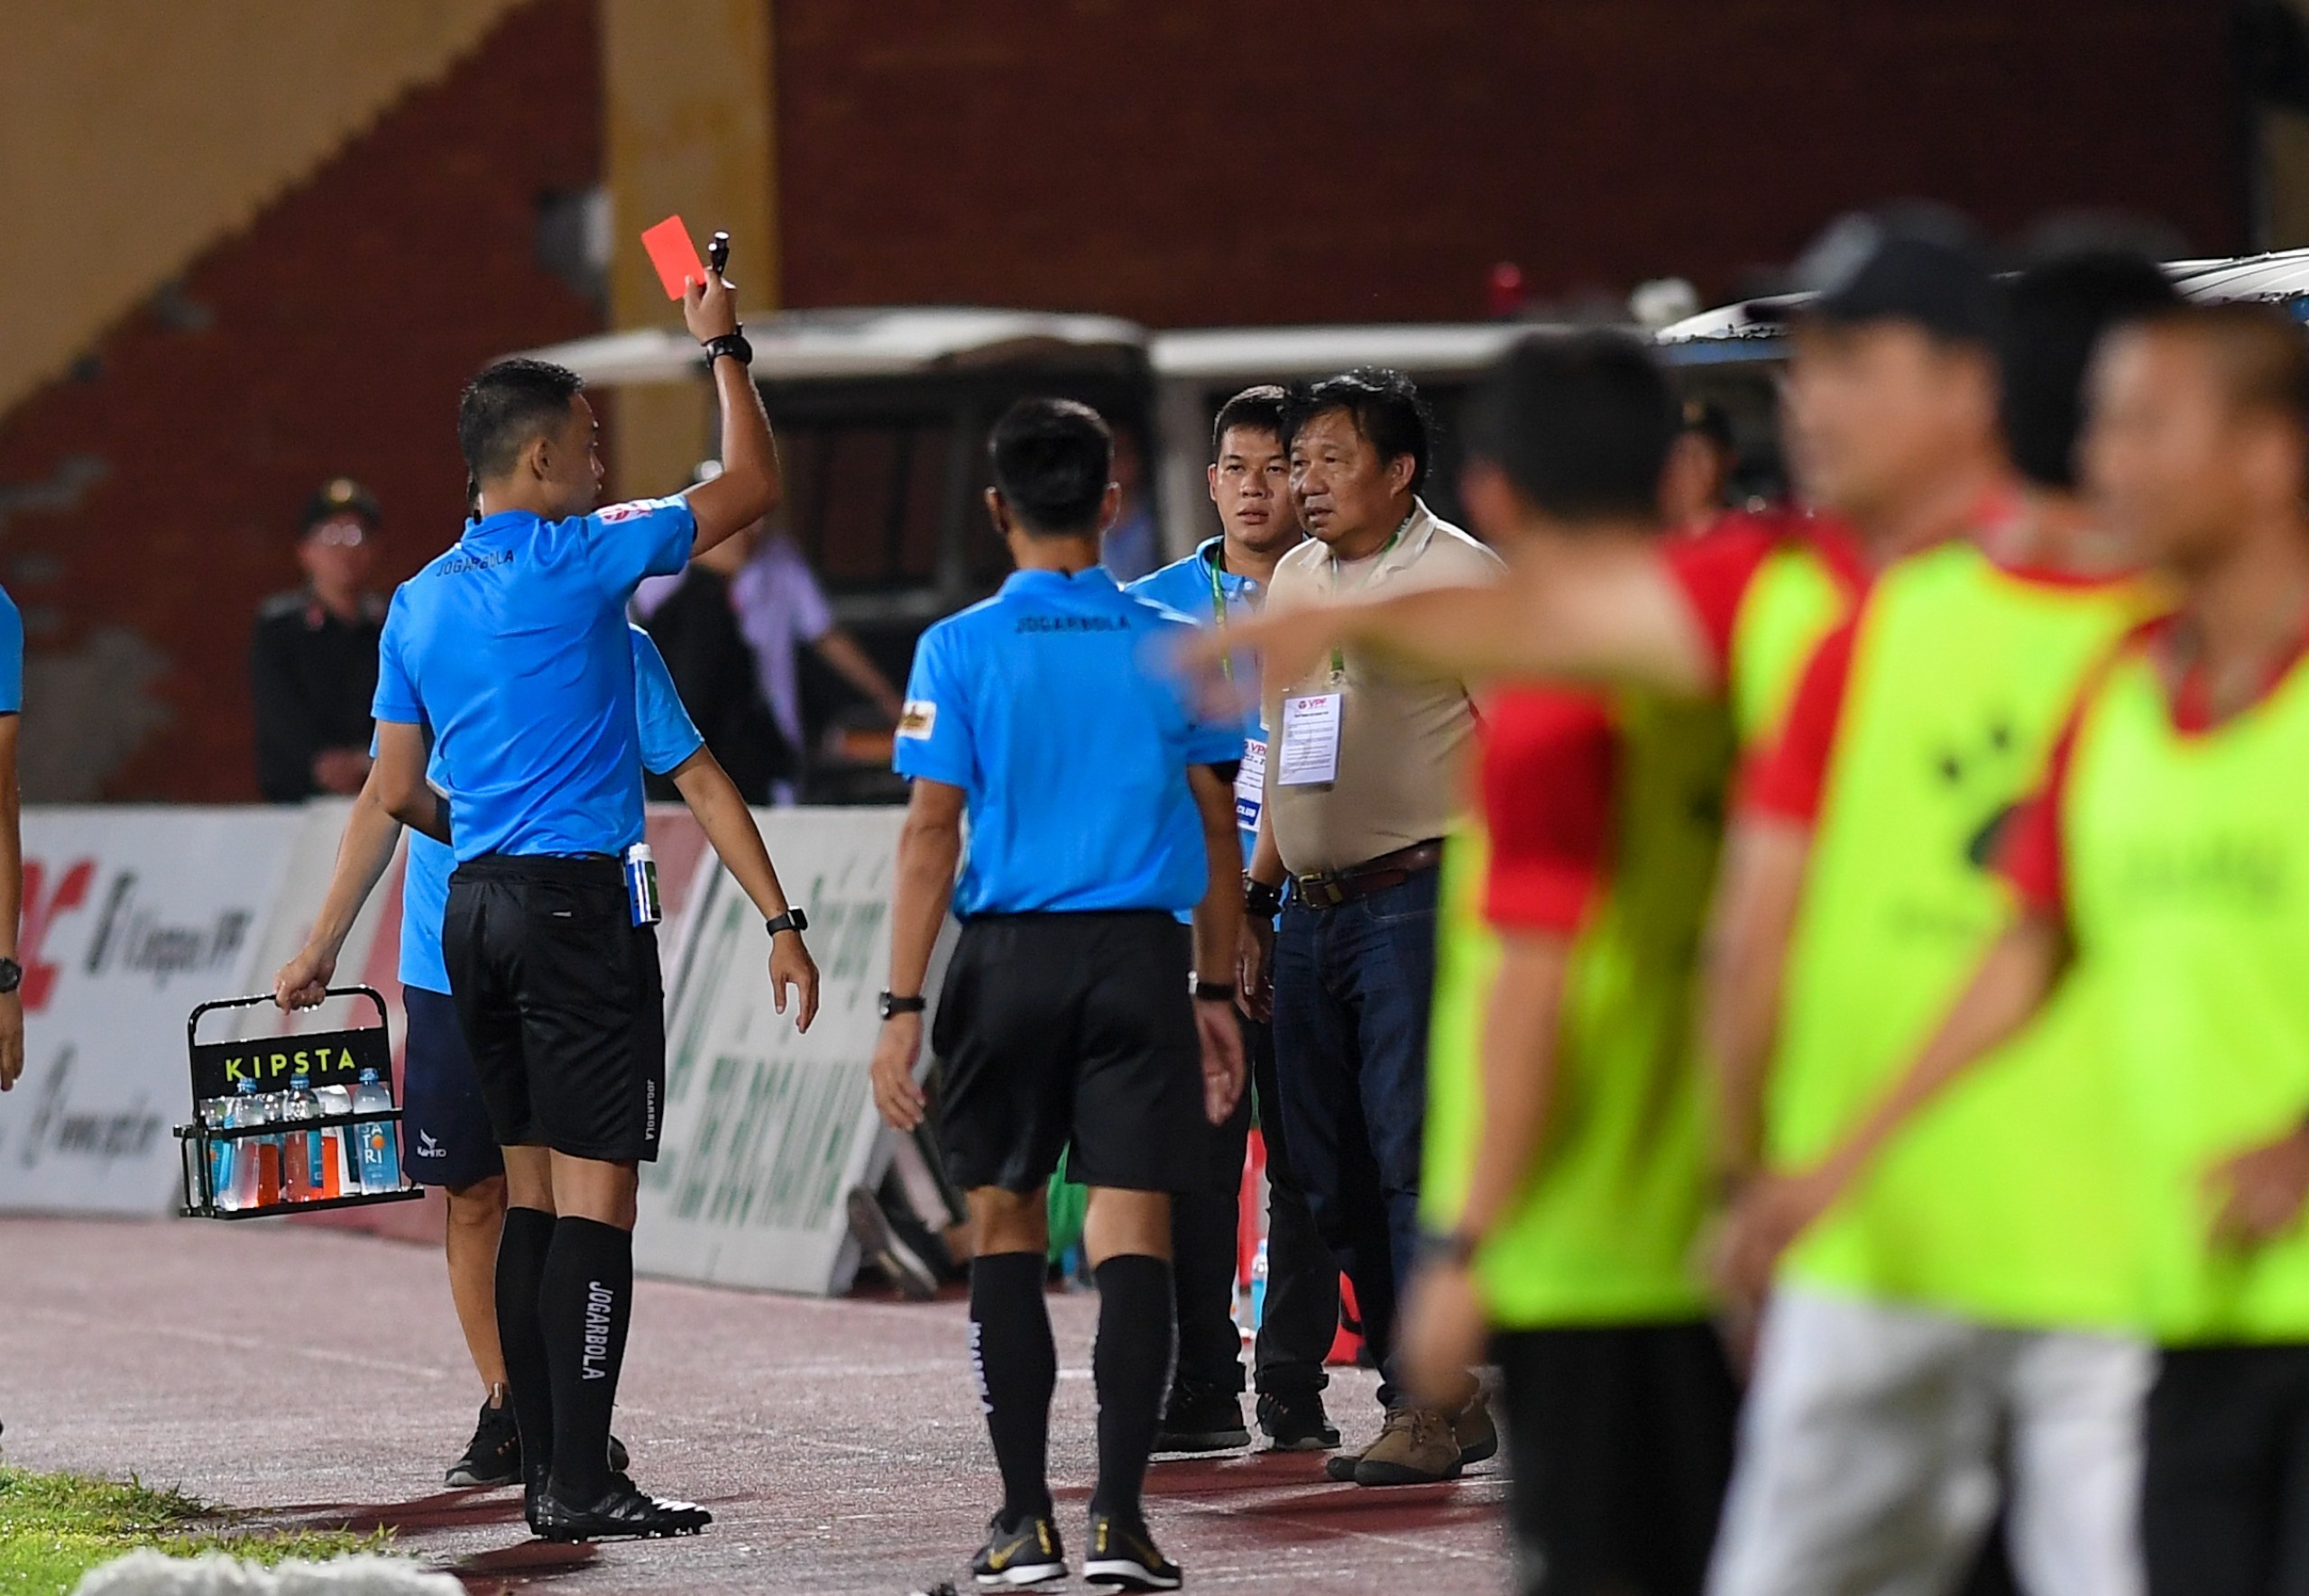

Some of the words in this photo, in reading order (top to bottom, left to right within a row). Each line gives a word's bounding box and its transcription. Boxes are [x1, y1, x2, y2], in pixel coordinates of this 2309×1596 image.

[226, 1047, 355, 1081] KIPSTA
[645, 1078, 655, 1141] JOGARBOLA
[582, 1281, 614, 1380] JOGARBOLA
